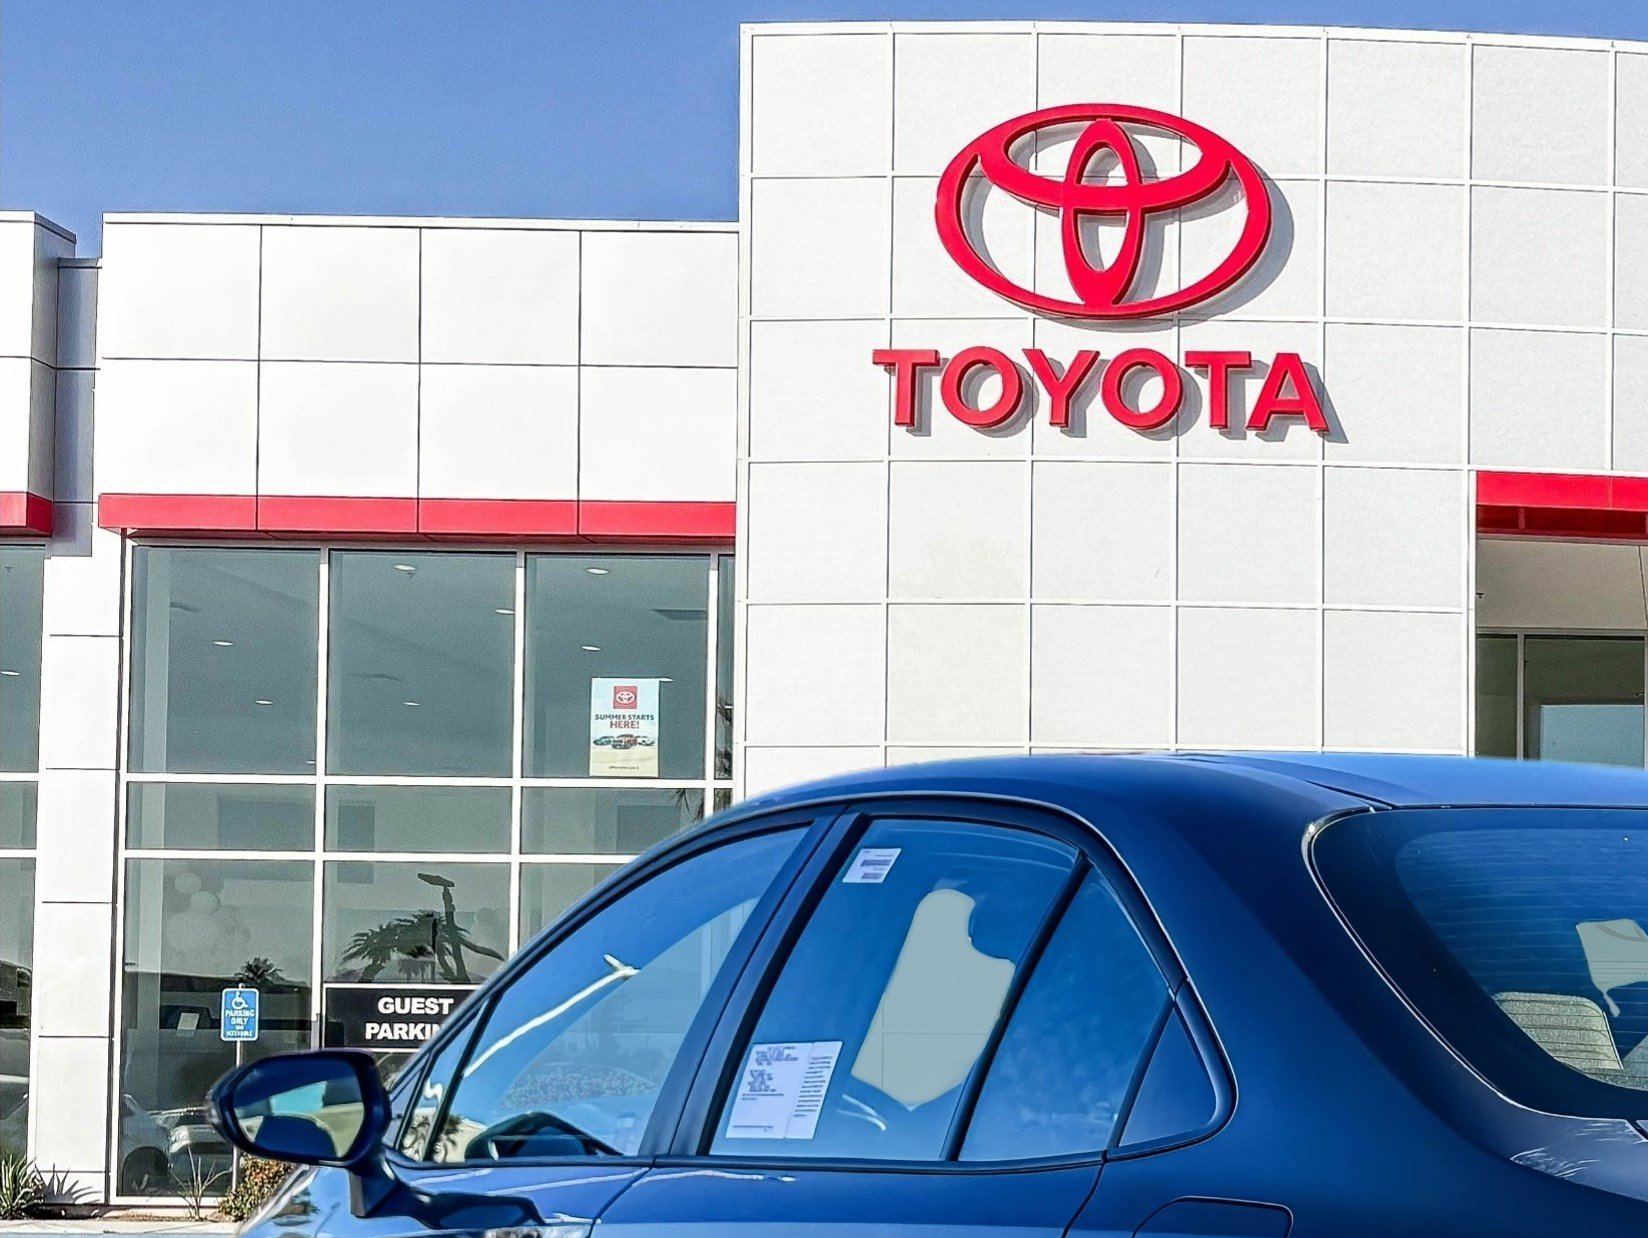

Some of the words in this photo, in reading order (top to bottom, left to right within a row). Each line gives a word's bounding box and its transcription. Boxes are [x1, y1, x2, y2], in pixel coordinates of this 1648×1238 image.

[872, 345, 1330, 433] TOYOTA
[610, 721, 640, 729] HERE!
[377, 997, 454, 1015] GUEST
[365, 1022, 441, 1040] PARKI
